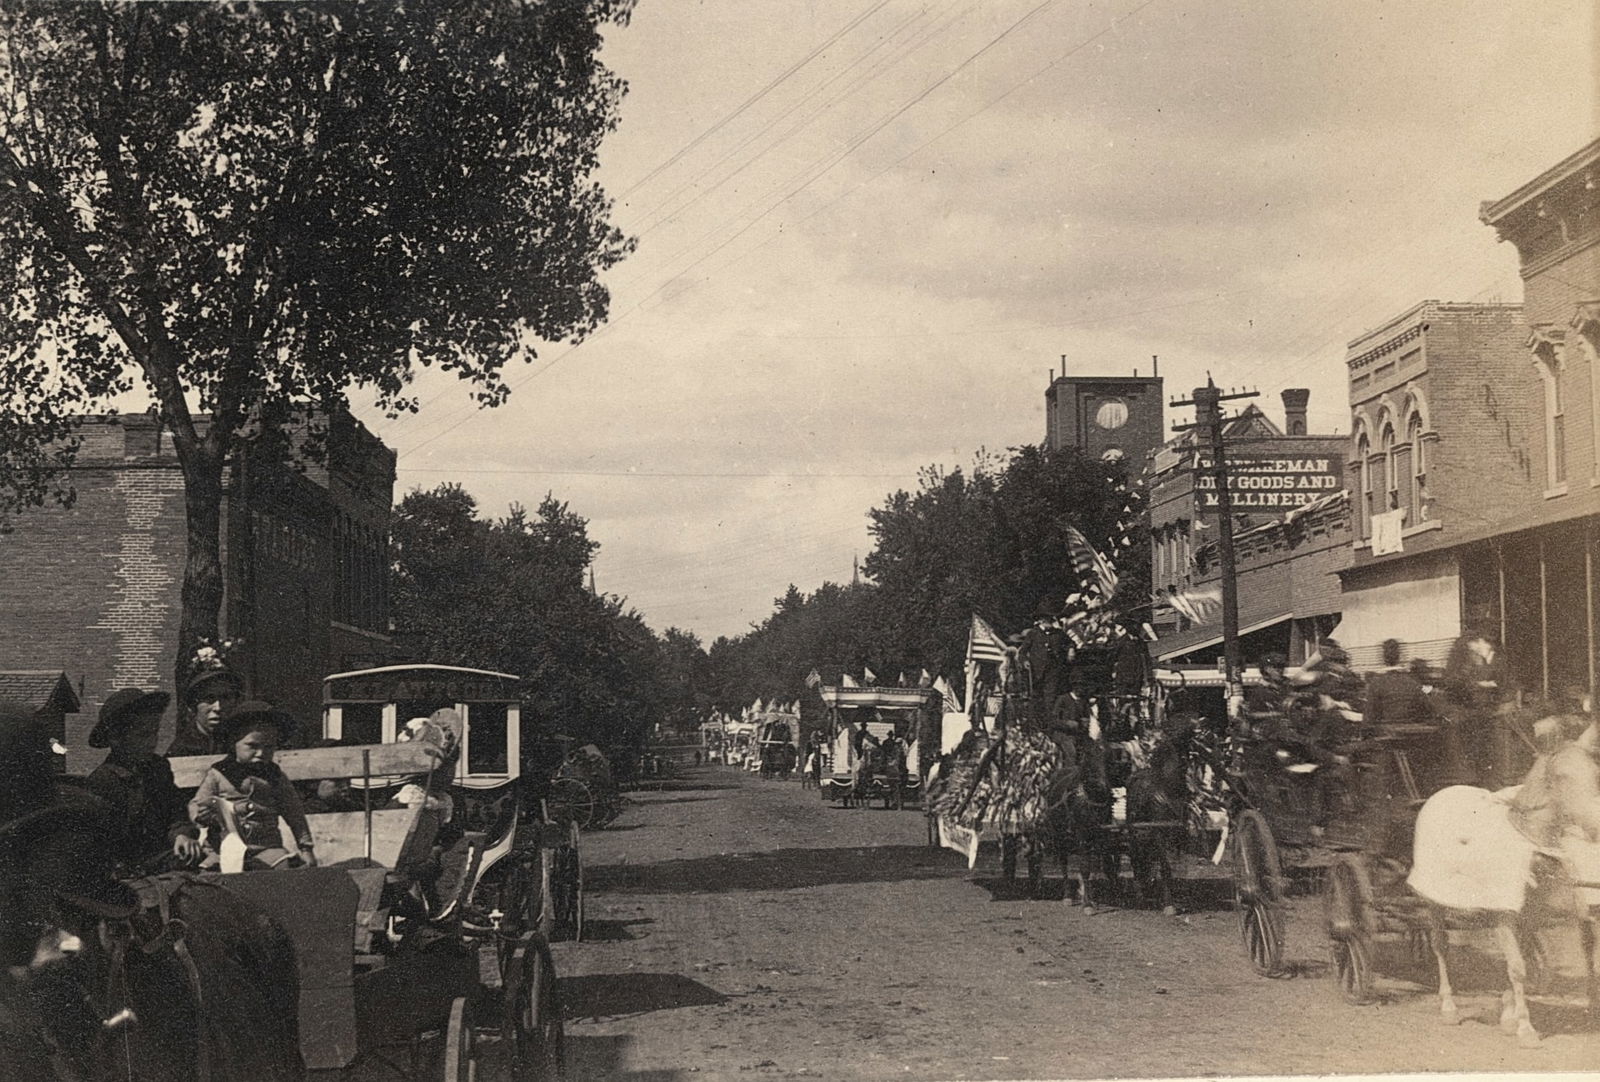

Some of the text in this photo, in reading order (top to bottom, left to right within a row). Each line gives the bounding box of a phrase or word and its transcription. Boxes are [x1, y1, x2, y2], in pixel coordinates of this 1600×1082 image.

[1237, 475, 1295, 489] GOODS
[1296, 475, 1336, 489] AND
[1205, 492, 1321, 506] MLLINERY
